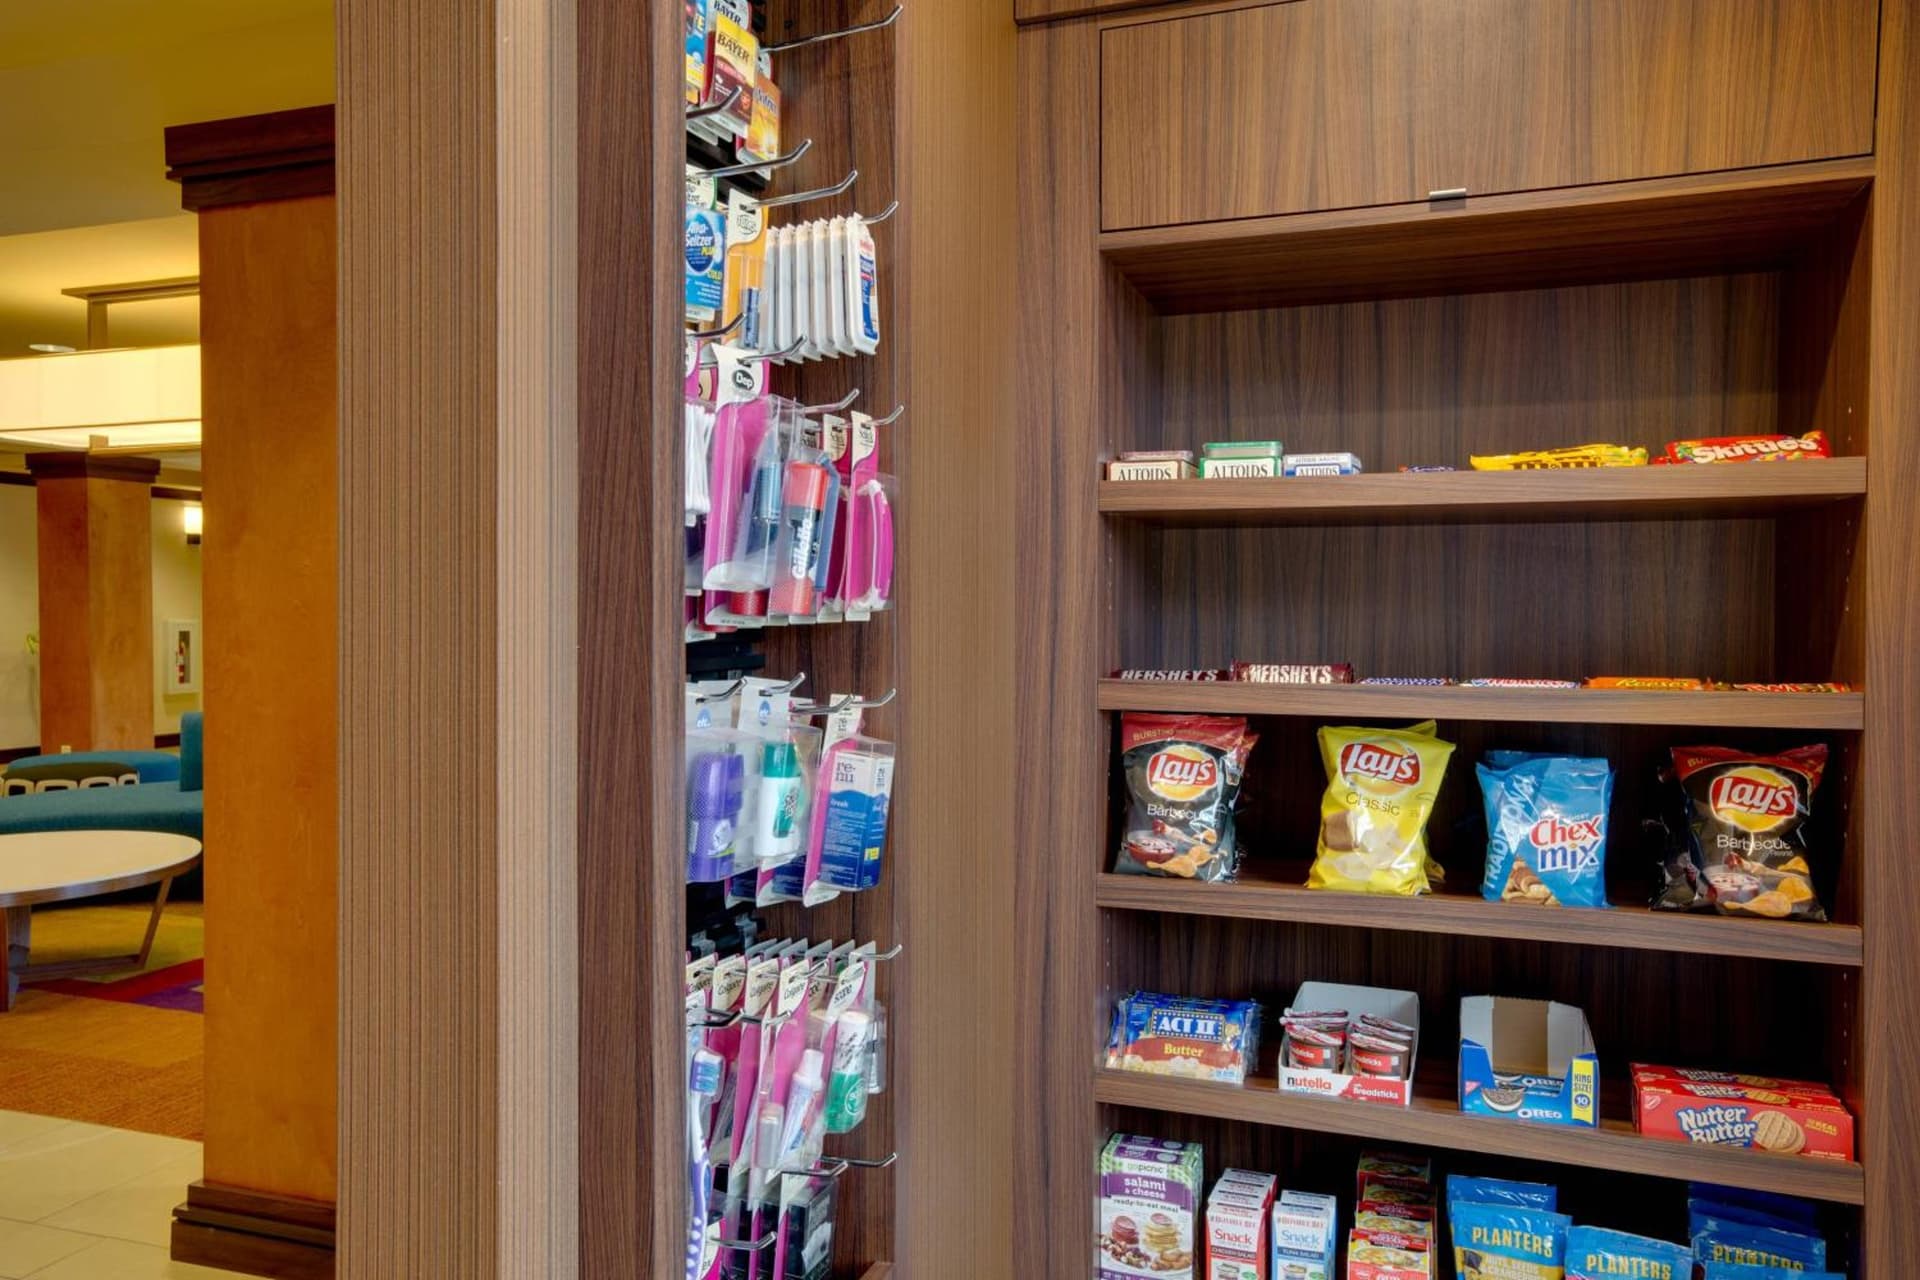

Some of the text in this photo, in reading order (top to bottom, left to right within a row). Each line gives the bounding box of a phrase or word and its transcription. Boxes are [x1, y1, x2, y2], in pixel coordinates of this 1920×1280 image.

[714, 1, 741, 25] BAYER
[717, 32, 750, 63] BAYER
[1693, 439, 1819, 463] Skittles
[1249, 665, 1332, 683] HERSHEY'S
[1150, 754, 1214, 785] Lay's
[1345, 744, 1416, 780] Lay's
[1346, 791, 1400, 816] Classic
[1717, 778, 1794, 814] Lay's
[1530, 815, 1602, 847] Chex
[1539, 839, 1600, 873] mix
[1158, 1016, 1216, 1036] ACT II
[1163, 1043, 1205, 1058] Butter
[1287, 1075, 1332, 1090] nutella
[1576, 1096, 1589, 1106] 10
[1517, 1108, 1563, 1119] OREO
[1679, 1106, 1747, 1131] Nutter
[1690, 1121, 1757, 1144] Butter
[1124, 1177, 1167, 1192] salami
[1132, 1188, 1166, 1200] cheese
[1215, 1228, 1253, 1245] Snack
[1281, 1229, 1320, 1245] Snack
[1472, 1226, 1553, 1258] PLANTERS
[1586, 1253, 1672, 1280] PLANTERS
